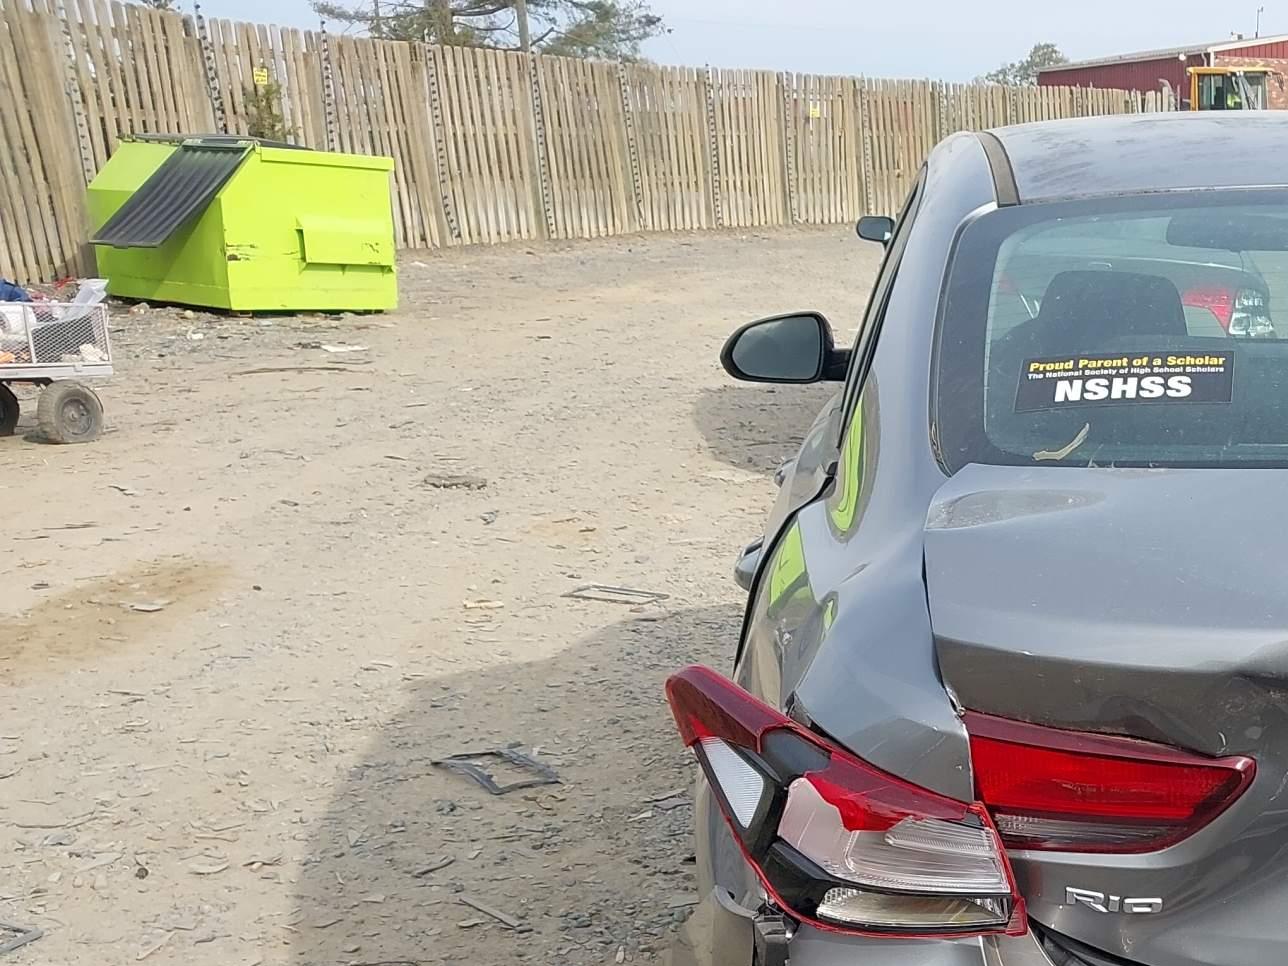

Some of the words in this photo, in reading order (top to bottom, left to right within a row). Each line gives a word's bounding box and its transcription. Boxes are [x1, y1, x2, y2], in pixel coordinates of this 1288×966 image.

[1029, 359, 1073, 372] Proud
[1079, 356, 1128, 369] Parent
[1132, 356, 1149, 367] of
[1153, 358, 1162, 367] a
[1166, 355, 1226, 366] Scholar
[1028, 373, 1043, 381] The
[1045, 370, 1082, 378] National
[1084, 368, 1117, 377] Society
[1130, 367, 1151, 375] High
[1153, 366, 1184, 374] School
[1054, 375, 1193, 402] NSHSS
